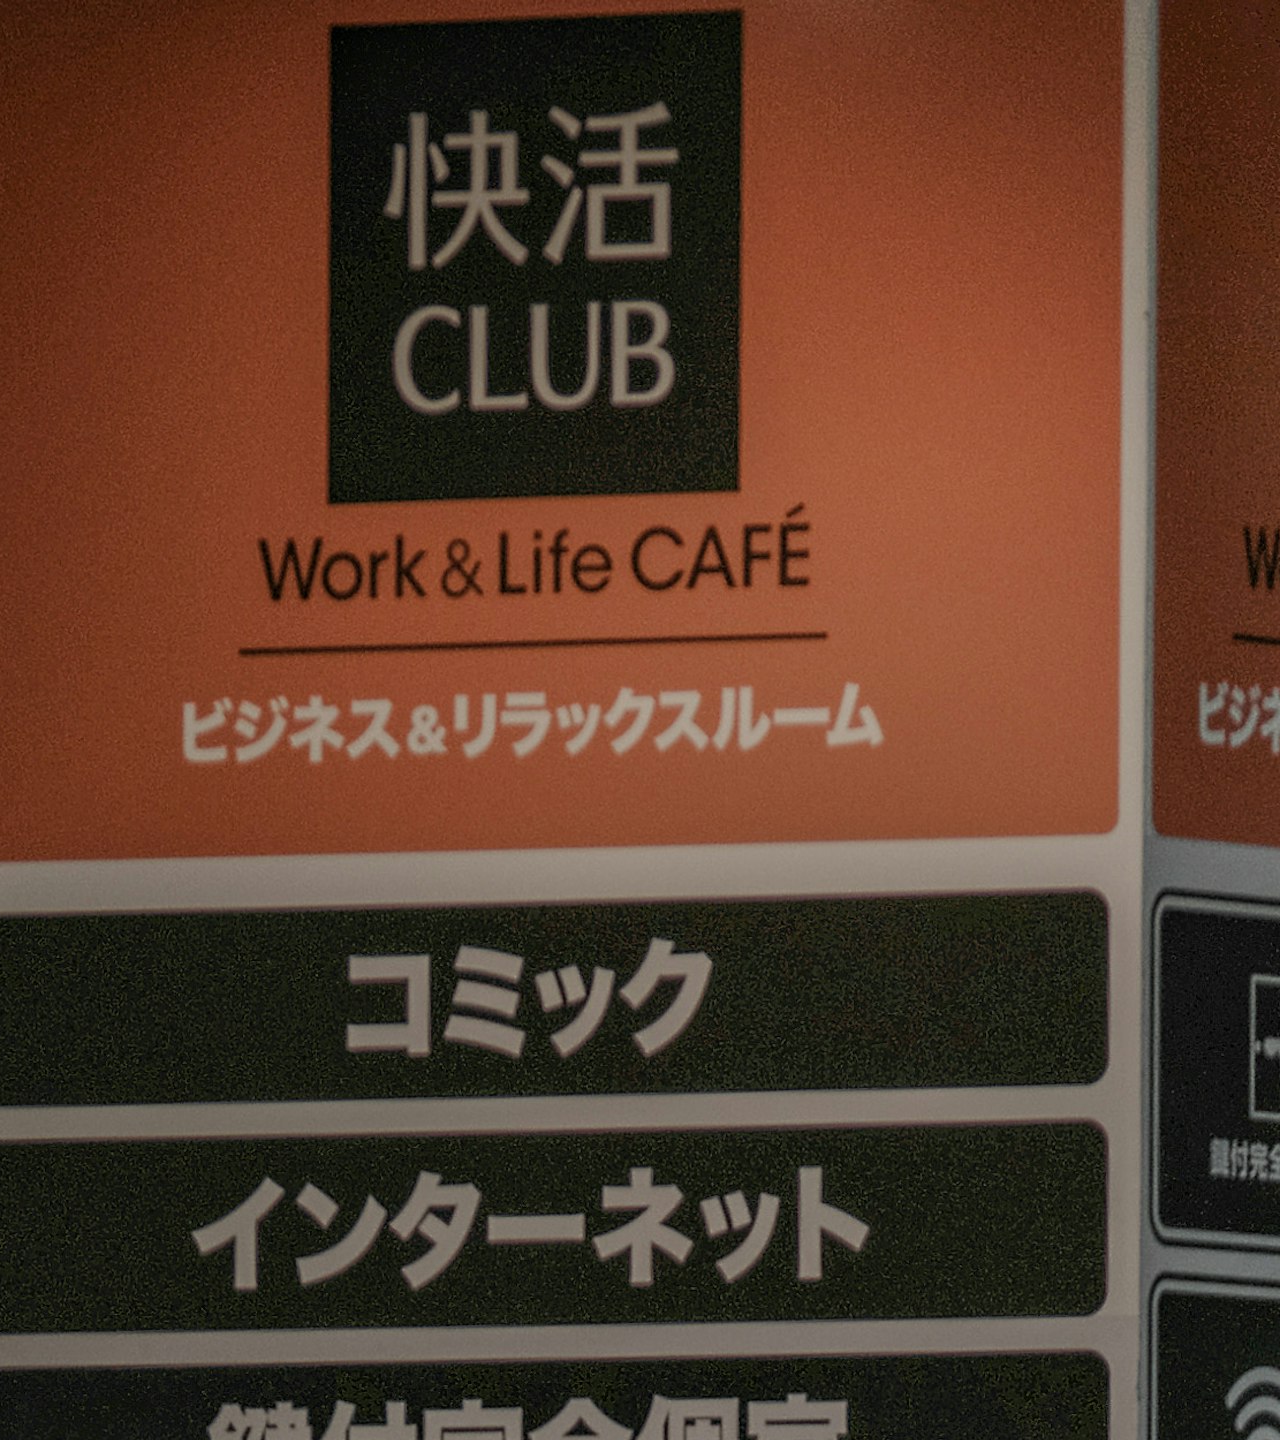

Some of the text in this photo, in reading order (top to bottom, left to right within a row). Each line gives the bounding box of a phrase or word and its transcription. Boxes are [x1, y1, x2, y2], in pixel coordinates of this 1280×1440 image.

[384, 101, 681, 270] 快活
[391, 299, 679, 414] CLUB
[259, 503, 813, 605] Work & Life CAFÉ
[180, 680, 885, 768] ビジネス&リラックスルーム
[347, 939, 712, 1058] コミック
[193, 1166, 871, 1291] インターネット
